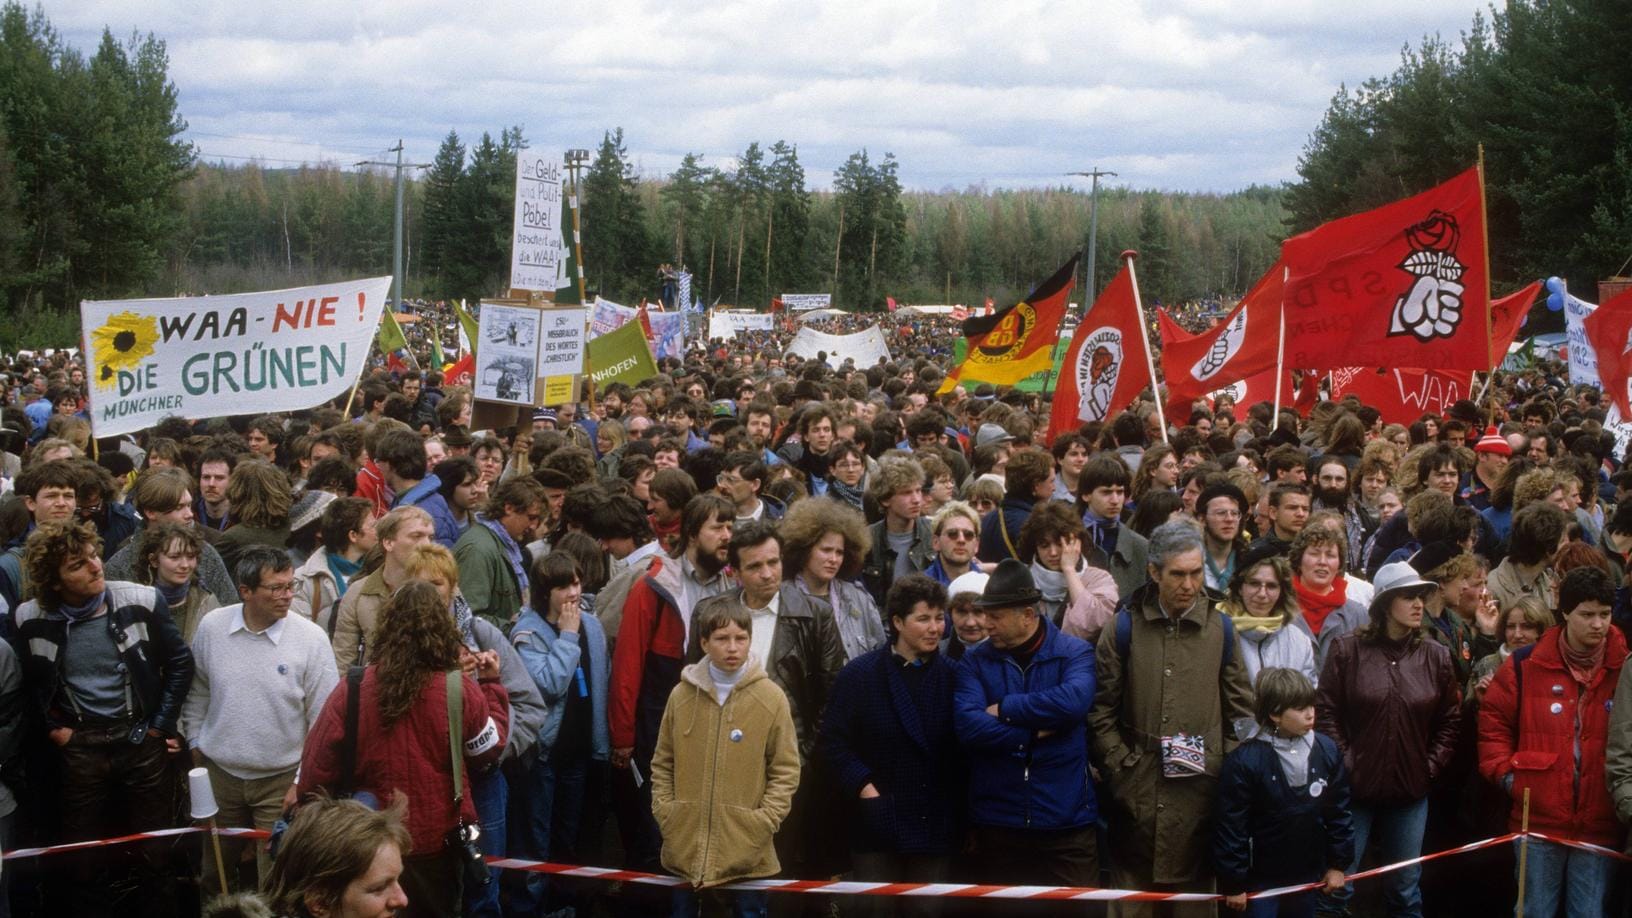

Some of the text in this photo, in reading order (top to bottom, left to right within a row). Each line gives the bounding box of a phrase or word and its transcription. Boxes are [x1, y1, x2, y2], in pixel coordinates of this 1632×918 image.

[535, 159, 561, 181] Geld-
[538, 182, 562, 203] Polit-
[523, 201, 552, 227] Pöbel
[159, 307, 248, 343] WAA
[545, 341, 556, 351] DES
[117, 341, 347, 397] DIE GRÜNEN
[1393, 367, 1460, 417] WAA
[103, 394, 183, 422] MÜNCHNER
